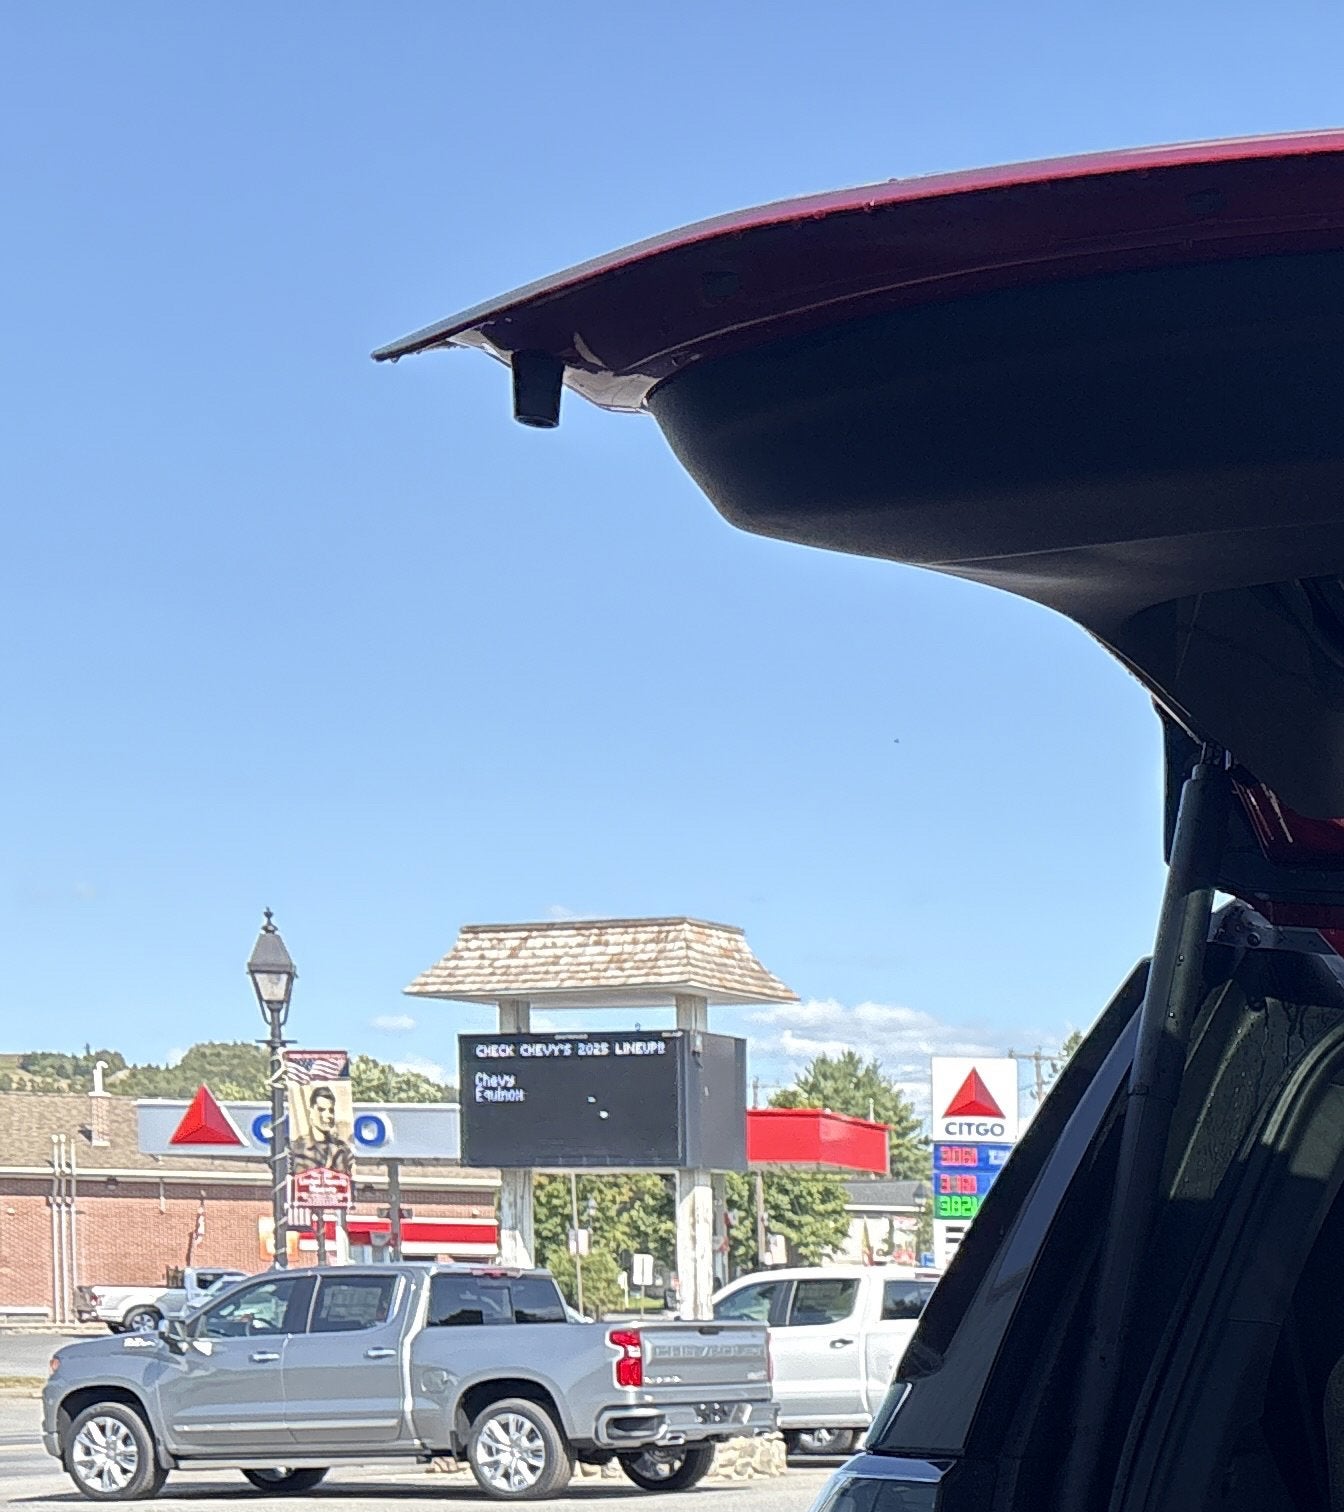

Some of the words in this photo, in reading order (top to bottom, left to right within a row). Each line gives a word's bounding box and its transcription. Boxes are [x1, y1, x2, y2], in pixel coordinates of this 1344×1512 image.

[476, 1044, 516, 1057] CHECK
[520, 1043, 572, 1057] CHEVY'S
[578, 1042, 609, 1056] 2025
[475, 1072, 516, 1088] Chevy
[945, 1122, 1004, 1136] CITGO
